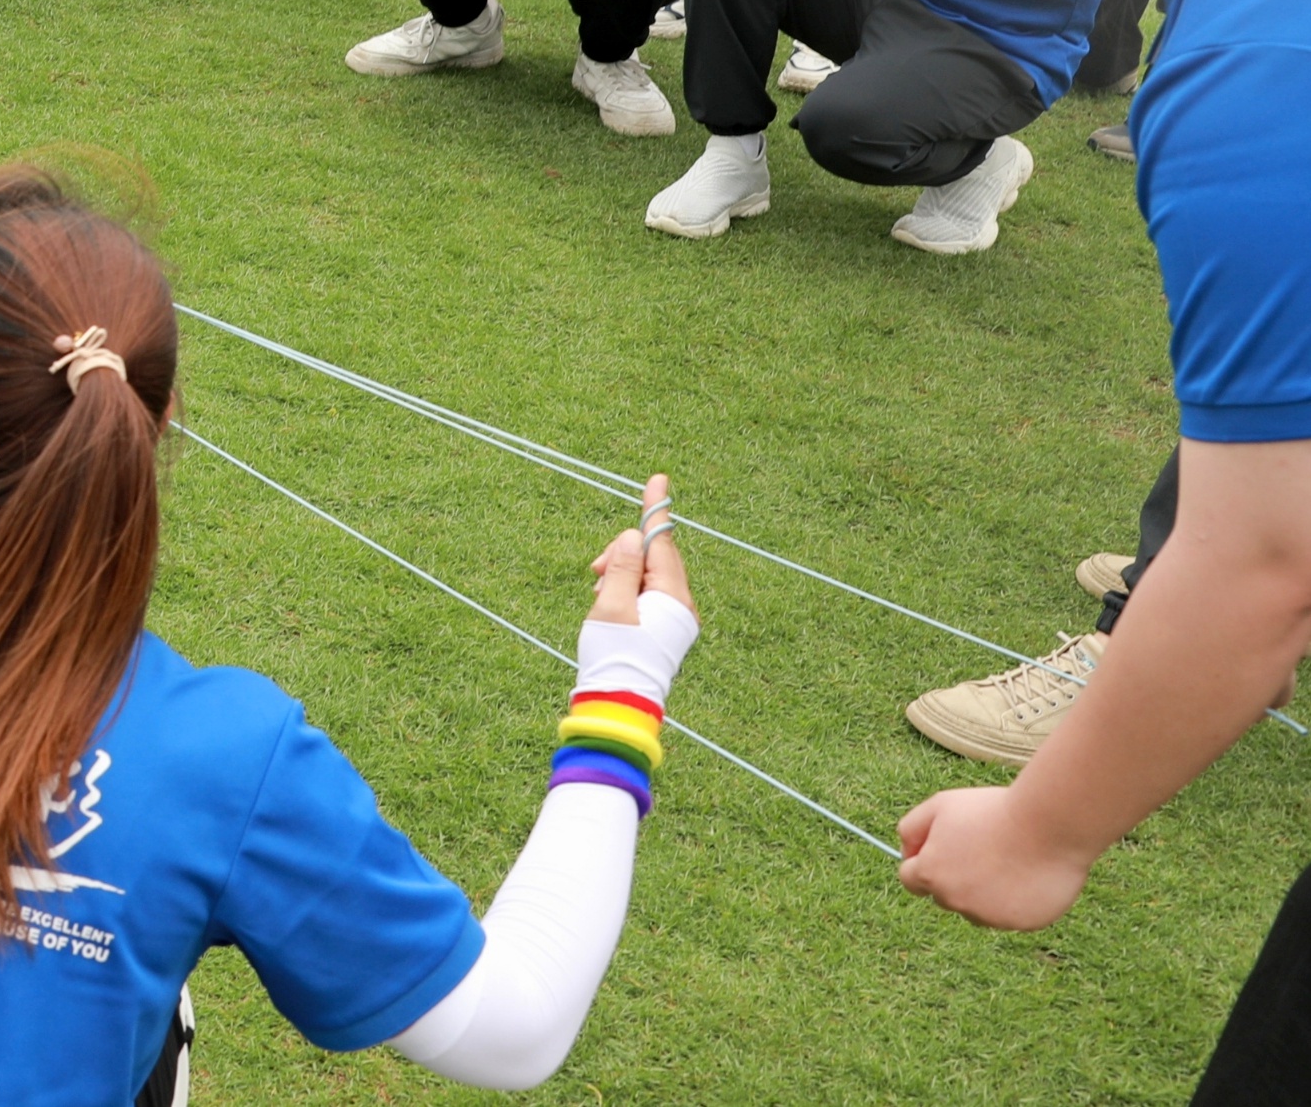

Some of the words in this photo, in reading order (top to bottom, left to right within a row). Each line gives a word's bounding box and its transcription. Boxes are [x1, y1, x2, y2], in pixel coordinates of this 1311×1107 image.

[20, 905, 114, 945] EXCELLENT
[42, 932, 70, 952] OF
[71, 939, 110, 963] YOU
